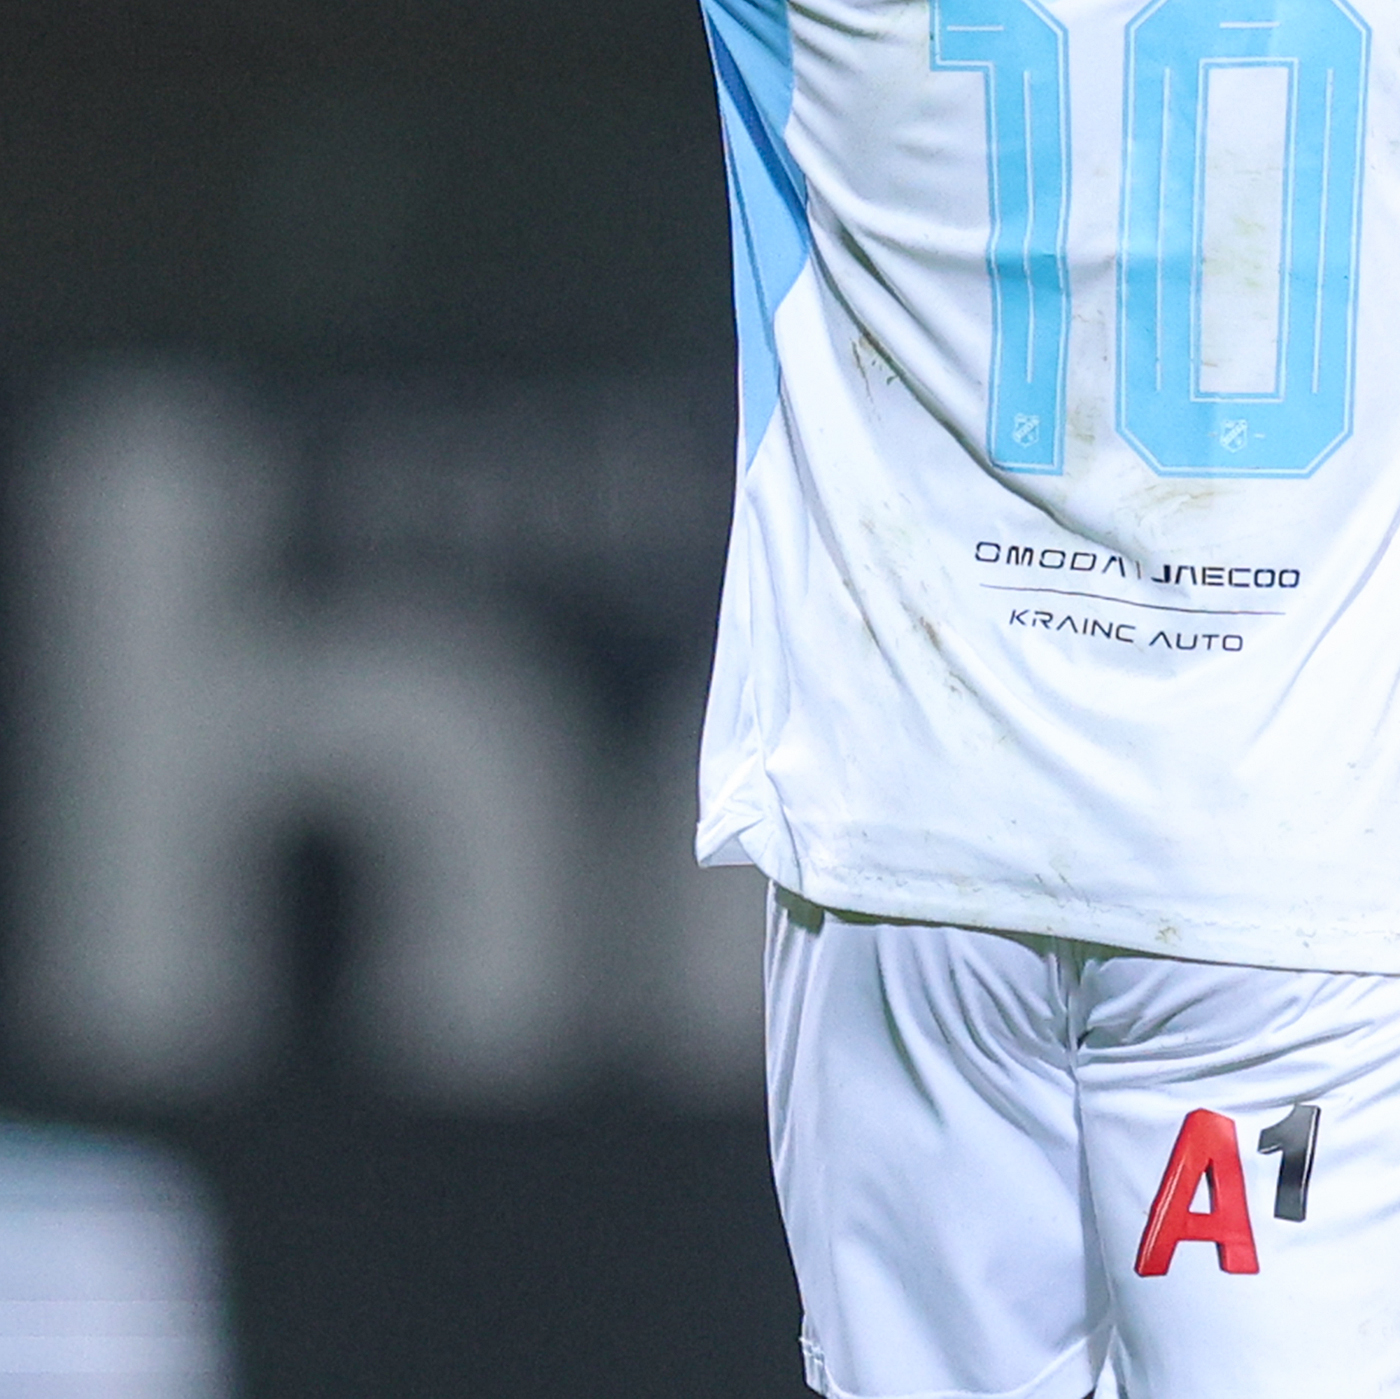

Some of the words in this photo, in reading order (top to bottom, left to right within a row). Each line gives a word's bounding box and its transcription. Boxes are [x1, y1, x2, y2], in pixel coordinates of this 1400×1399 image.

[975, 541, 1126, 578] OMODA
[1151, 564, 1300, 589] JAECOO
[1009, 609, 1136, 643] KRAINC
[1149, 631, 1243, 652] AUTO
[1134, 1104, 1321, 1277] A1
